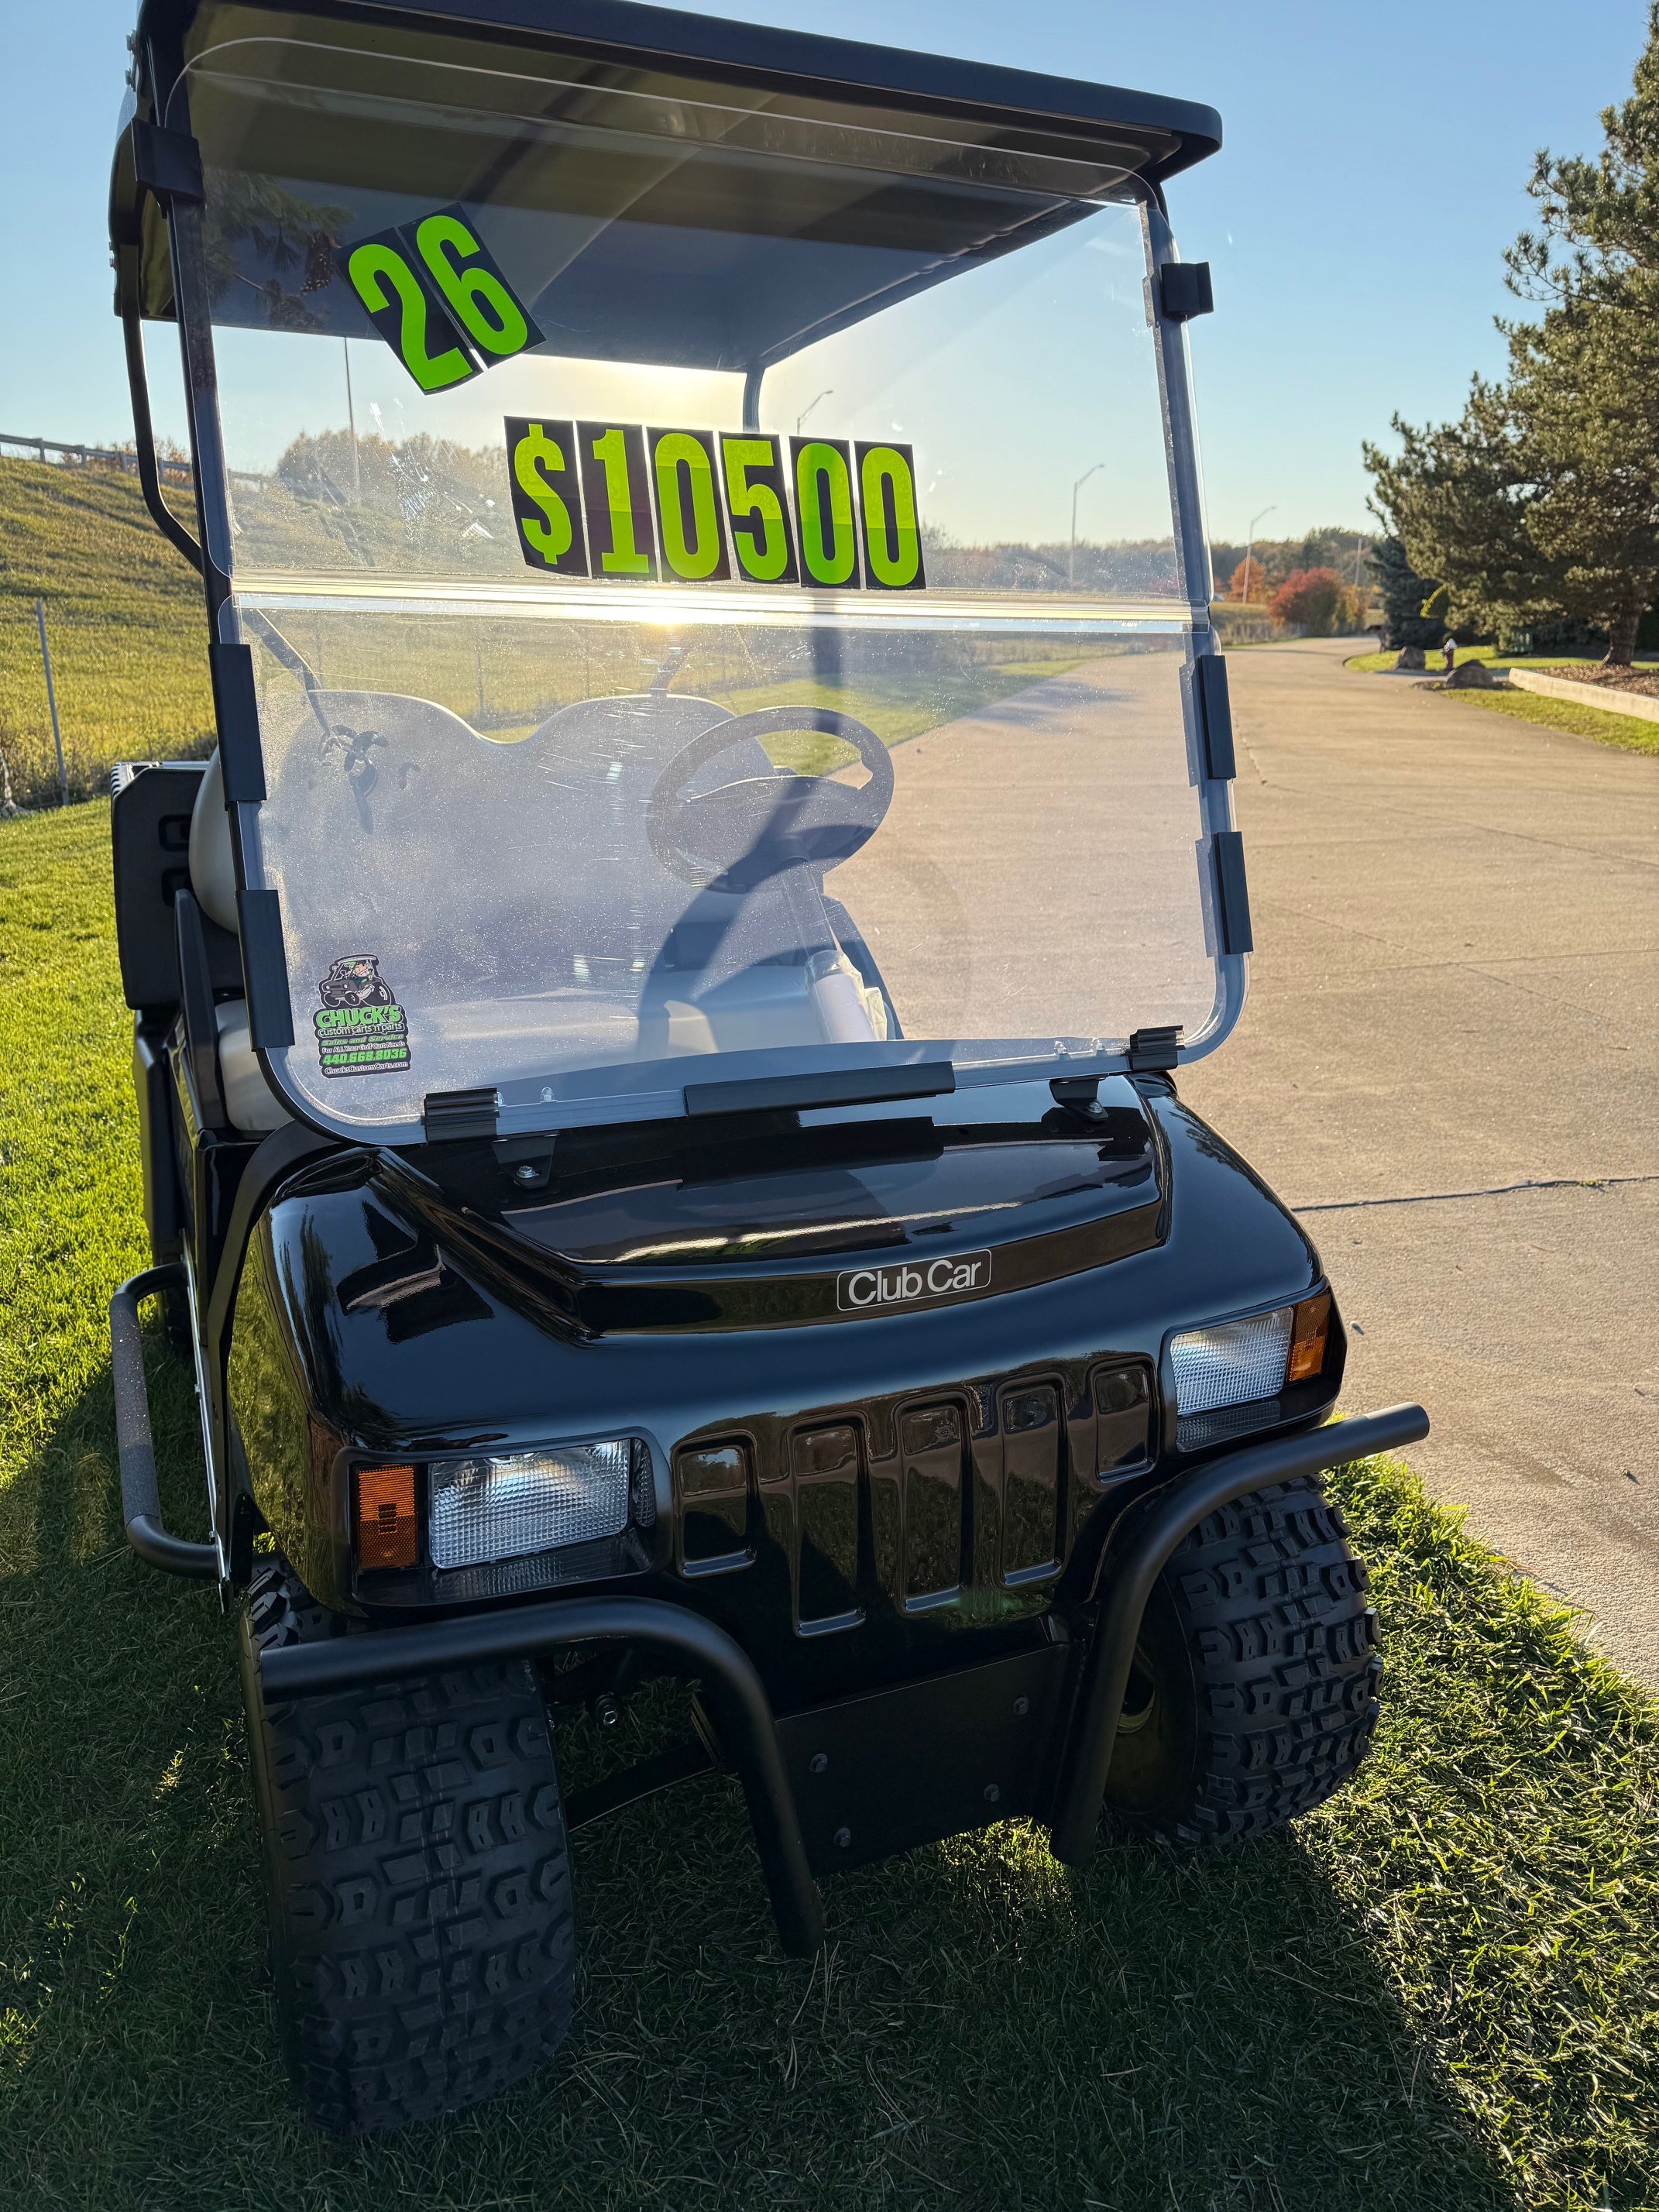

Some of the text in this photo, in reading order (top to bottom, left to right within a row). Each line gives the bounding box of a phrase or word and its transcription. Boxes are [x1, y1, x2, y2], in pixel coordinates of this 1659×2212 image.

[349, 215, 527, 390] 26
[514, 424, 919, 586] $10500
[316, 1005, 401, 1029] CHUCK'S
[319, 1028, 351, 1036] custom
[382, 1023, 402, 1032] parts
[368, 1034, 404, 1042] Service
[323, 1048, 407, 1065] 440.668.8036
[325, 1062, 408, 1074] ChucksCustomCarts.com
[848, 1259, 982, 1305] Club Car
